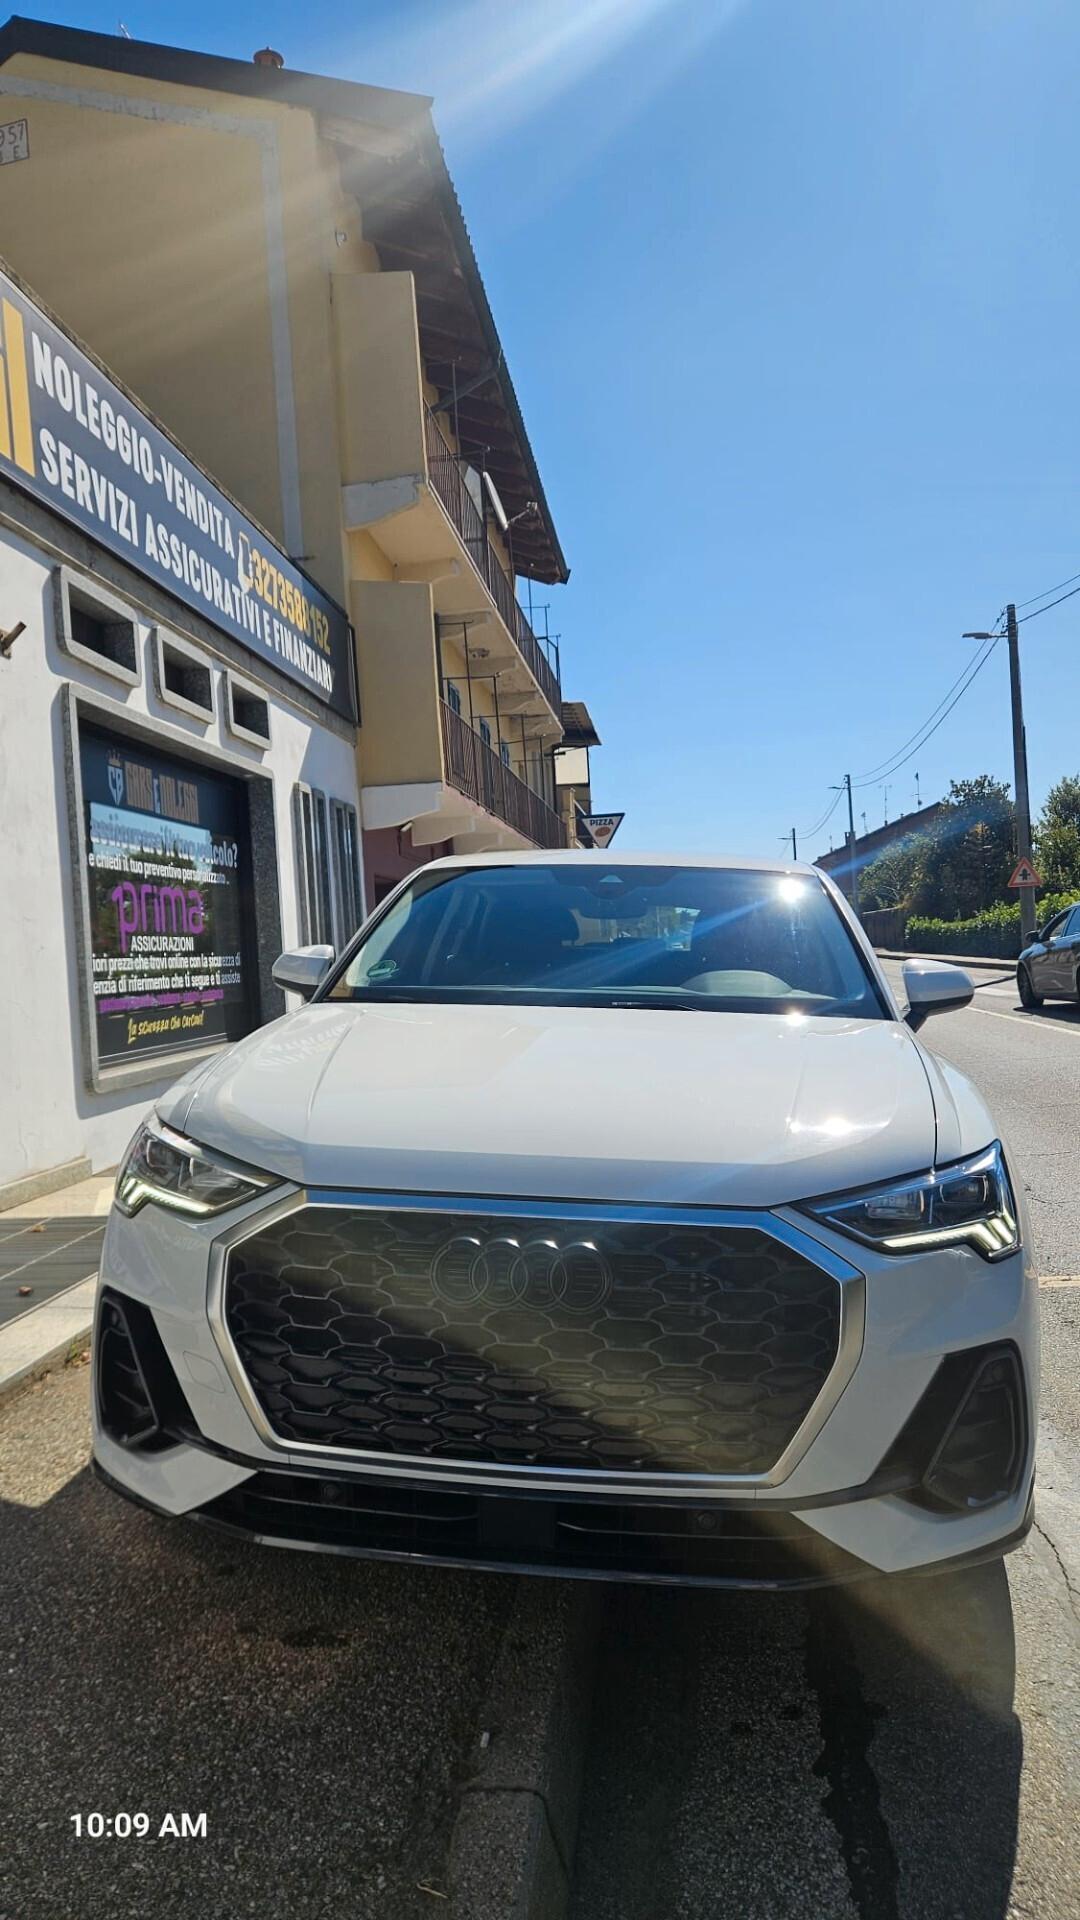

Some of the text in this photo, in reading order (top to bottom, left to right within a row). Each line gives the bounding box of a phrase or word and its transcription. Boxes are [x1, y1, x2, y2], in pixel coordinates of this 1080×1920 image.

[31, 331, 235, 559] NOLEGGIO-VENDITA
[39, 428, 333, 693] SERVIZI ASSICURATIVI E FINANZIARI
[590, 818, 614, 826] PIZZA
[96, 853, 121, 871] chiedi
[130, 861, 143, 874] tuo
[144, 863, 182, 879] preventivo
[112, 881, 205, 954] prima
[131, 936, 194, 952] ASSICURAZIONI
[109, 953, 134, 976] prezzi
[135, 954, 149, 970] che
[150, 953, 167, 969] trovi
[189, 956, 200, 968] con
[201, 953, 208, 968] la
[119, 973, 126, 991] di
[128, 973, 170, 991] riferimento
[171, 973, 183, 988] che
[184, 971, 190, 987] ti
